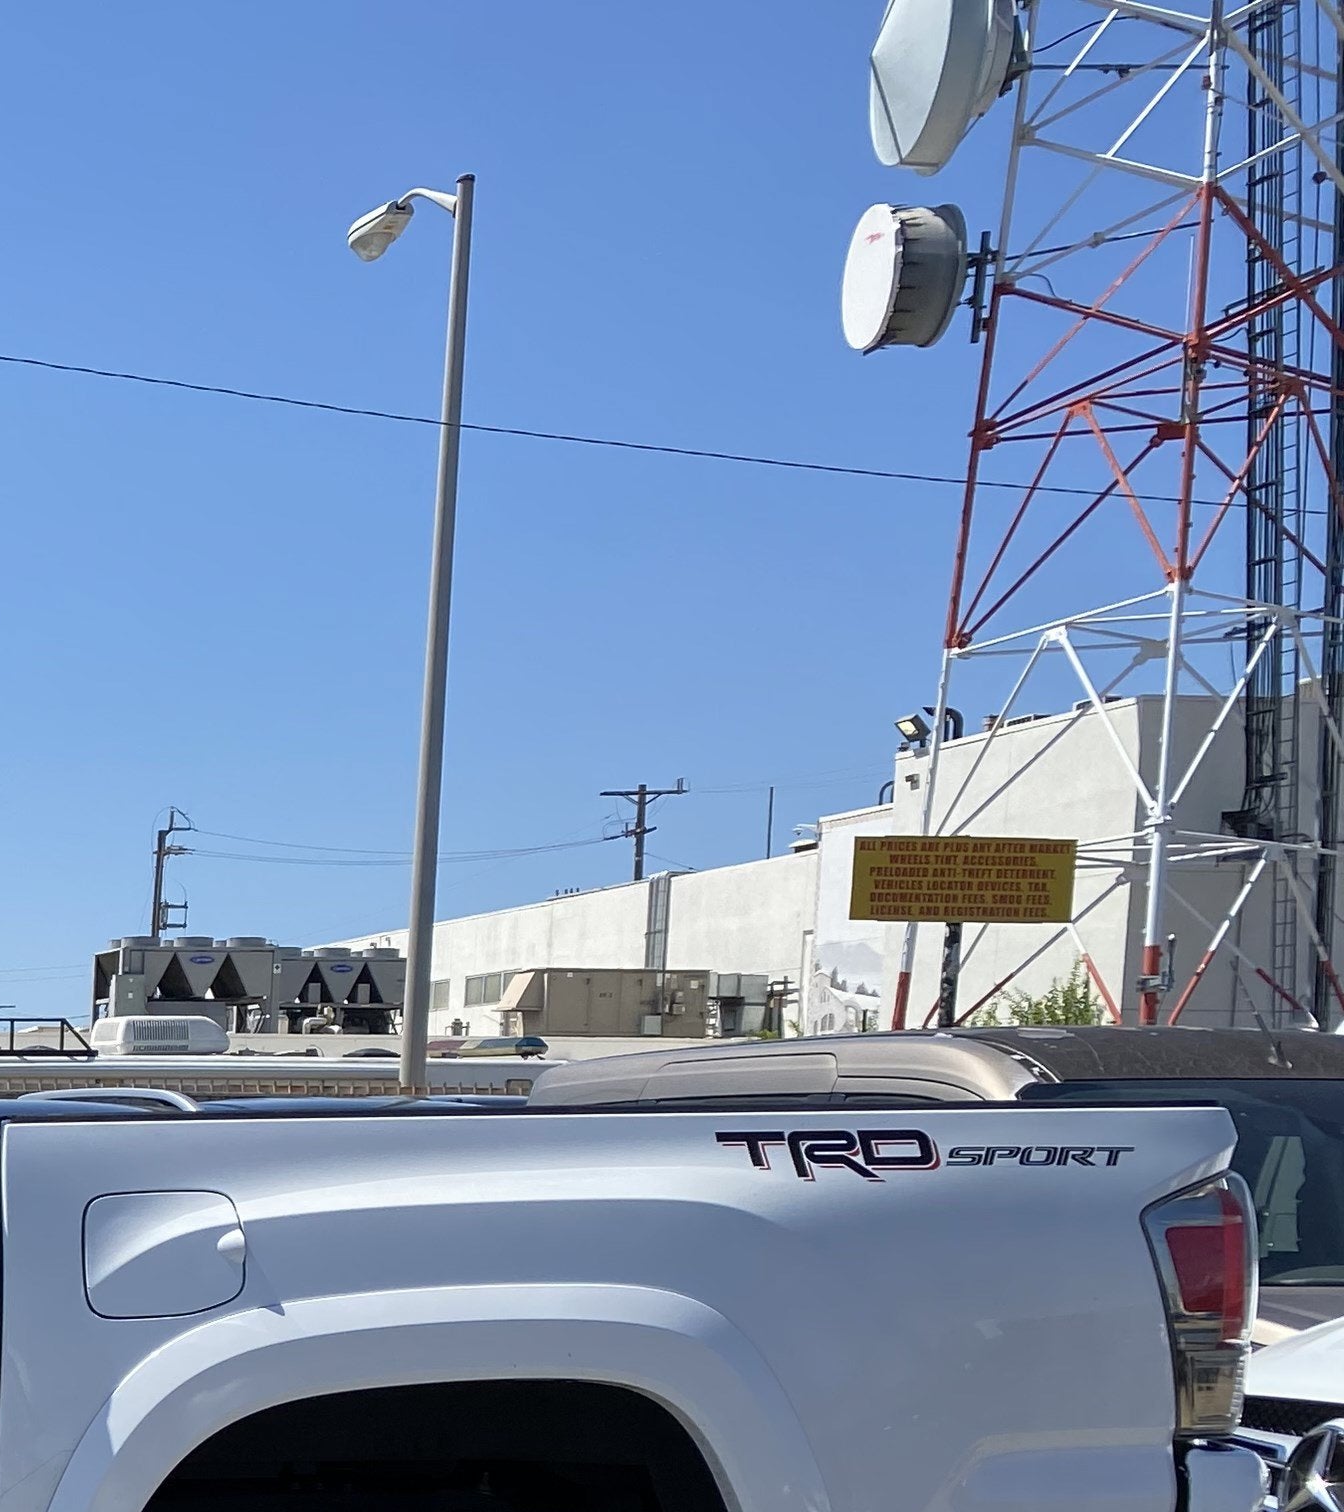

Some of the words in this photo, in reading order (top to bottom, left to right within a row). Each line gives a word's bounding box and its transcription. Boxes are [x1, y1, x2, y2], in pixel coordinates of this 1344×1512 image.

[859, 841, 876, 851] ALL
[880, 841, 917, 852] PRICES
[920, 841, 940, 852] ARE
[943, 842, 969, 853] PLUS
[972, 842, 992, 853] ANY
[994, 843, 1026, 854] AFTER
[1029, 843, 1072, 855] MARKET
[869, 867, 929, 878] PRELOADED
[873, 879, 923, 890] VEHICLES
[927, 880, 974, 892] LOCATOR
[869, 892, 959, 904] DOCUMENTATION
[992, 894, 1022, 905] SMOG
[919, 906, 940, 917] AND
[944, 906, 1020, 918] REGISTRATION
[715, 1129, 941, 1182] TRD
[945, 1146, 1135, 1168] SPORT
